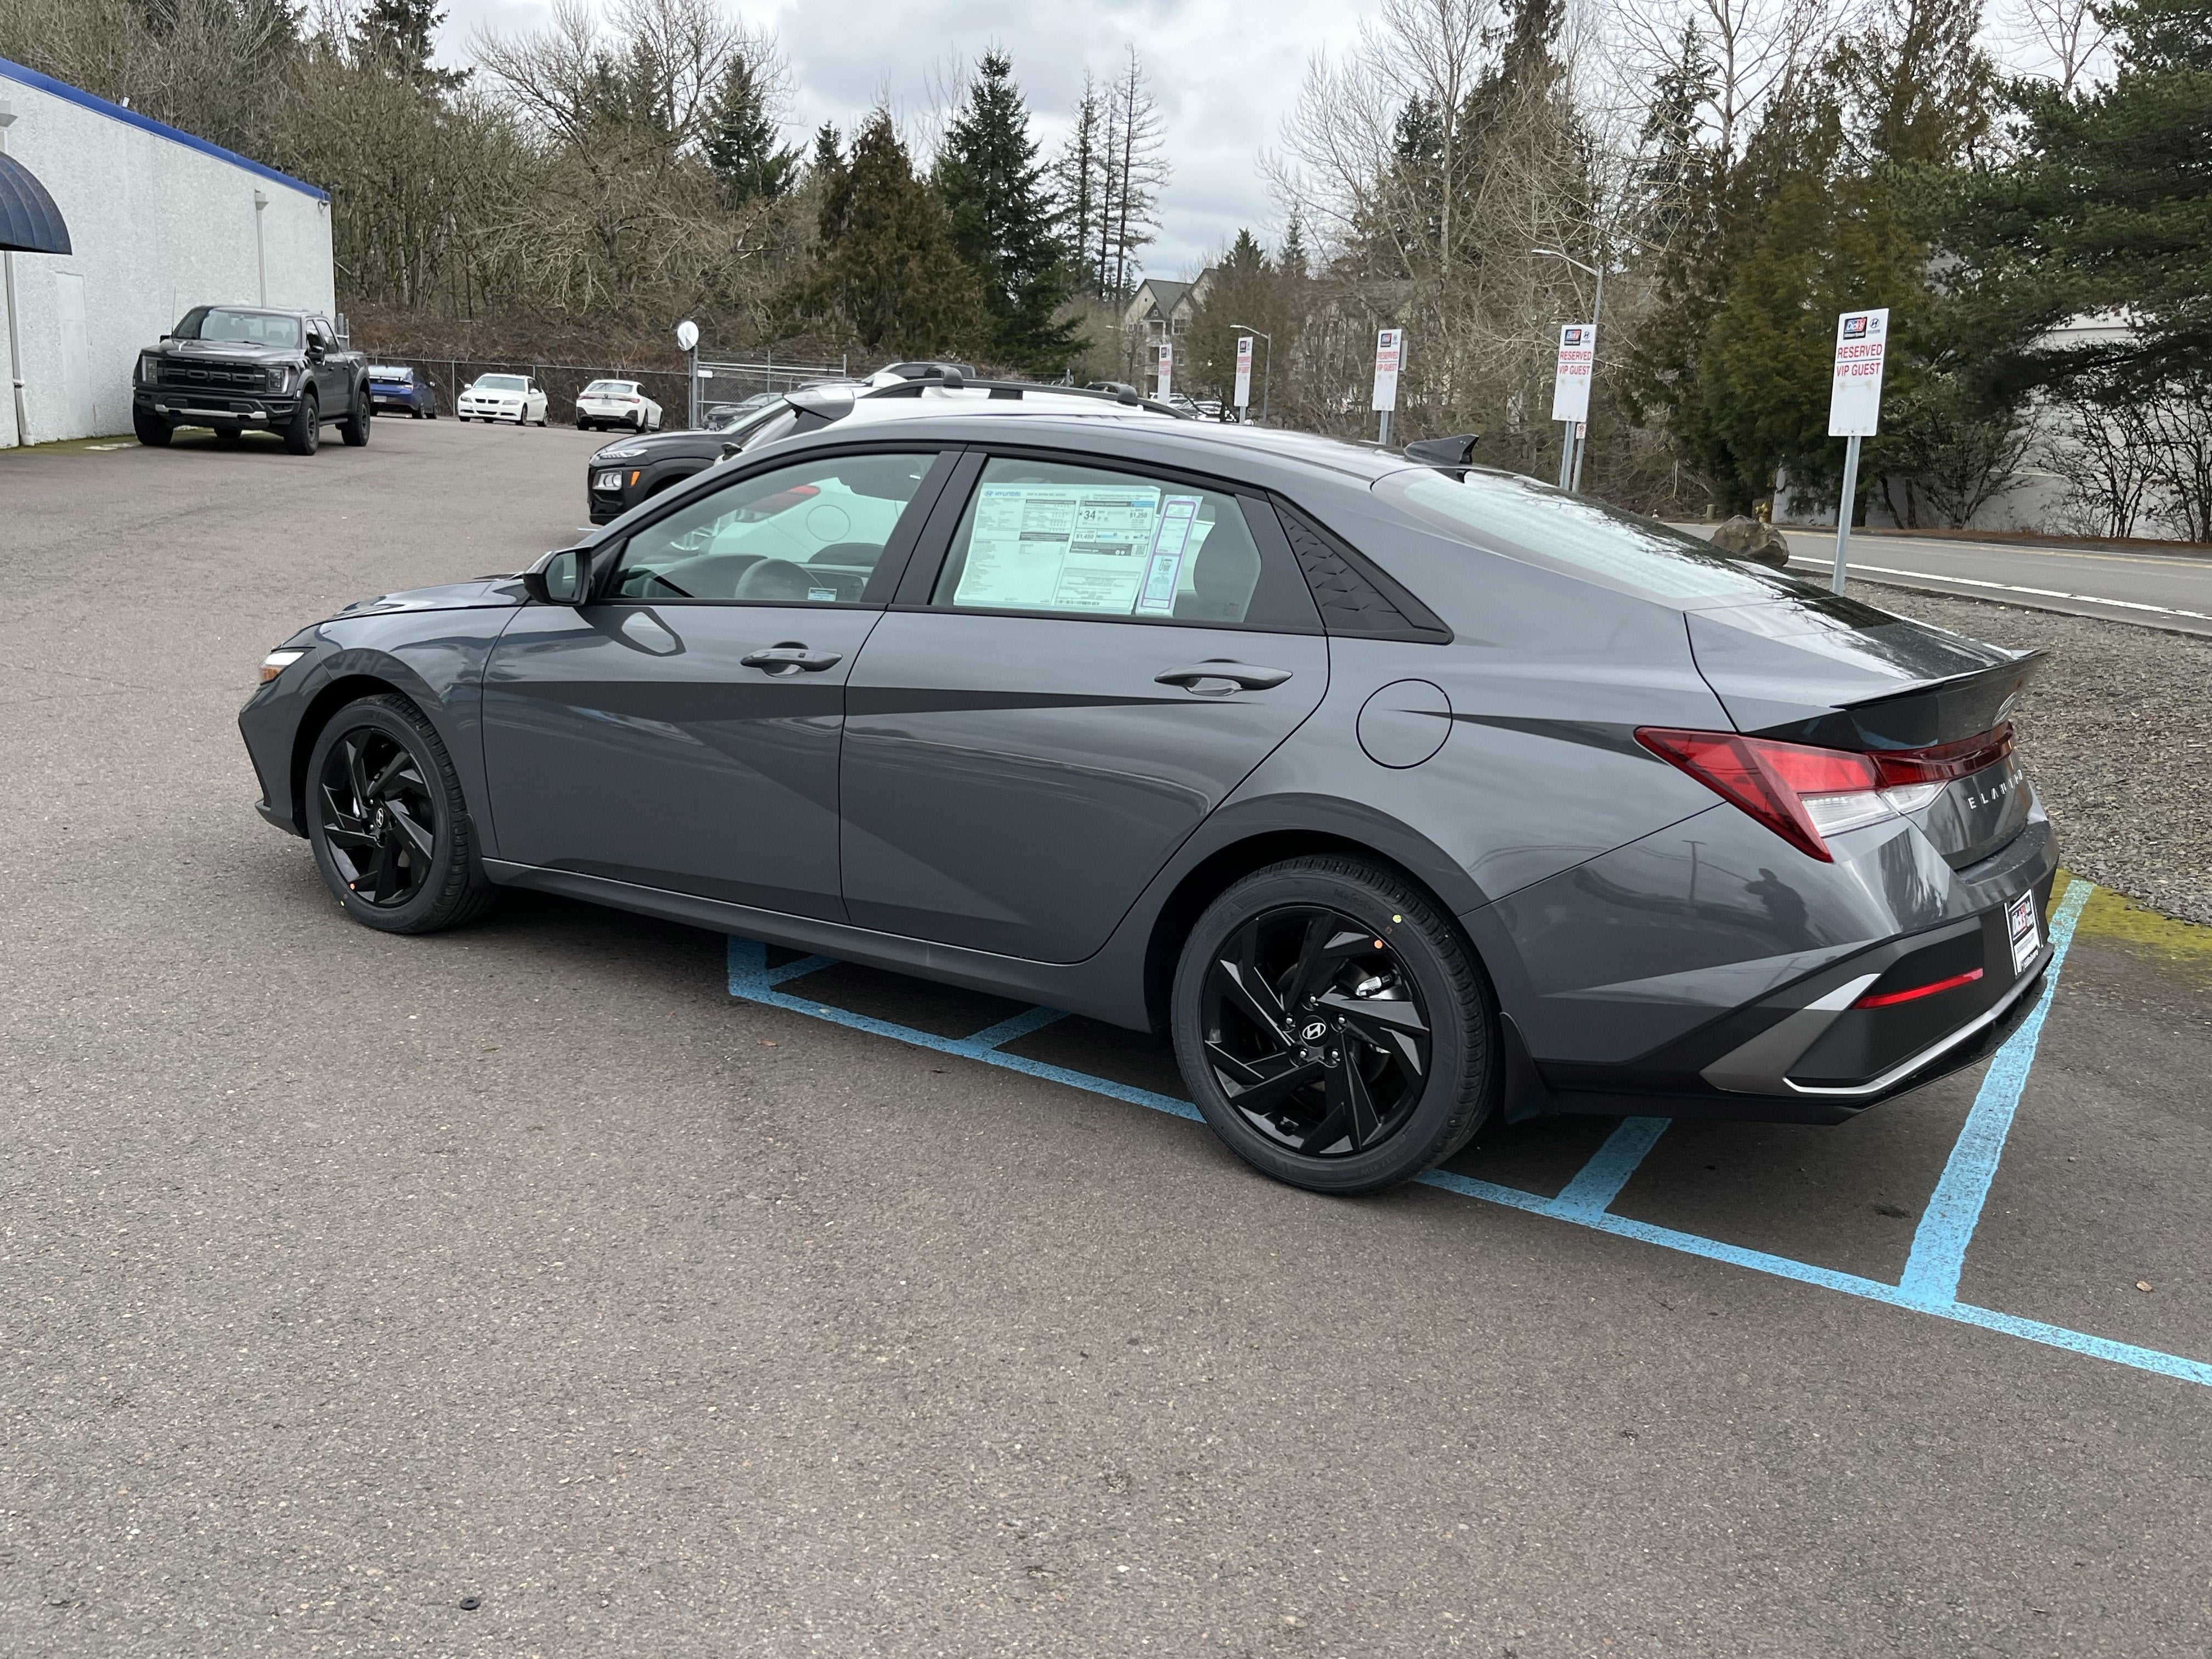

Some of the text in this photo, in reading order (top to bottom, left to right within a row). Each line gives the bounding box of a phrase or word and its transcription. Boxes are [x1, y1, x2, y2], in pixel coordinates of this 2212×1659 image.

[1560, 351, 1592, 360] RESERVED
[1837, 344, 1882, 359] RESERVED
[163, 368, 255, 383] FORD
[1559, 365, 1590, 375] VIP GUEST
[1837, 363, 1881, 377] VIP GUEST
[1084, 510, 1096, 520] 34
